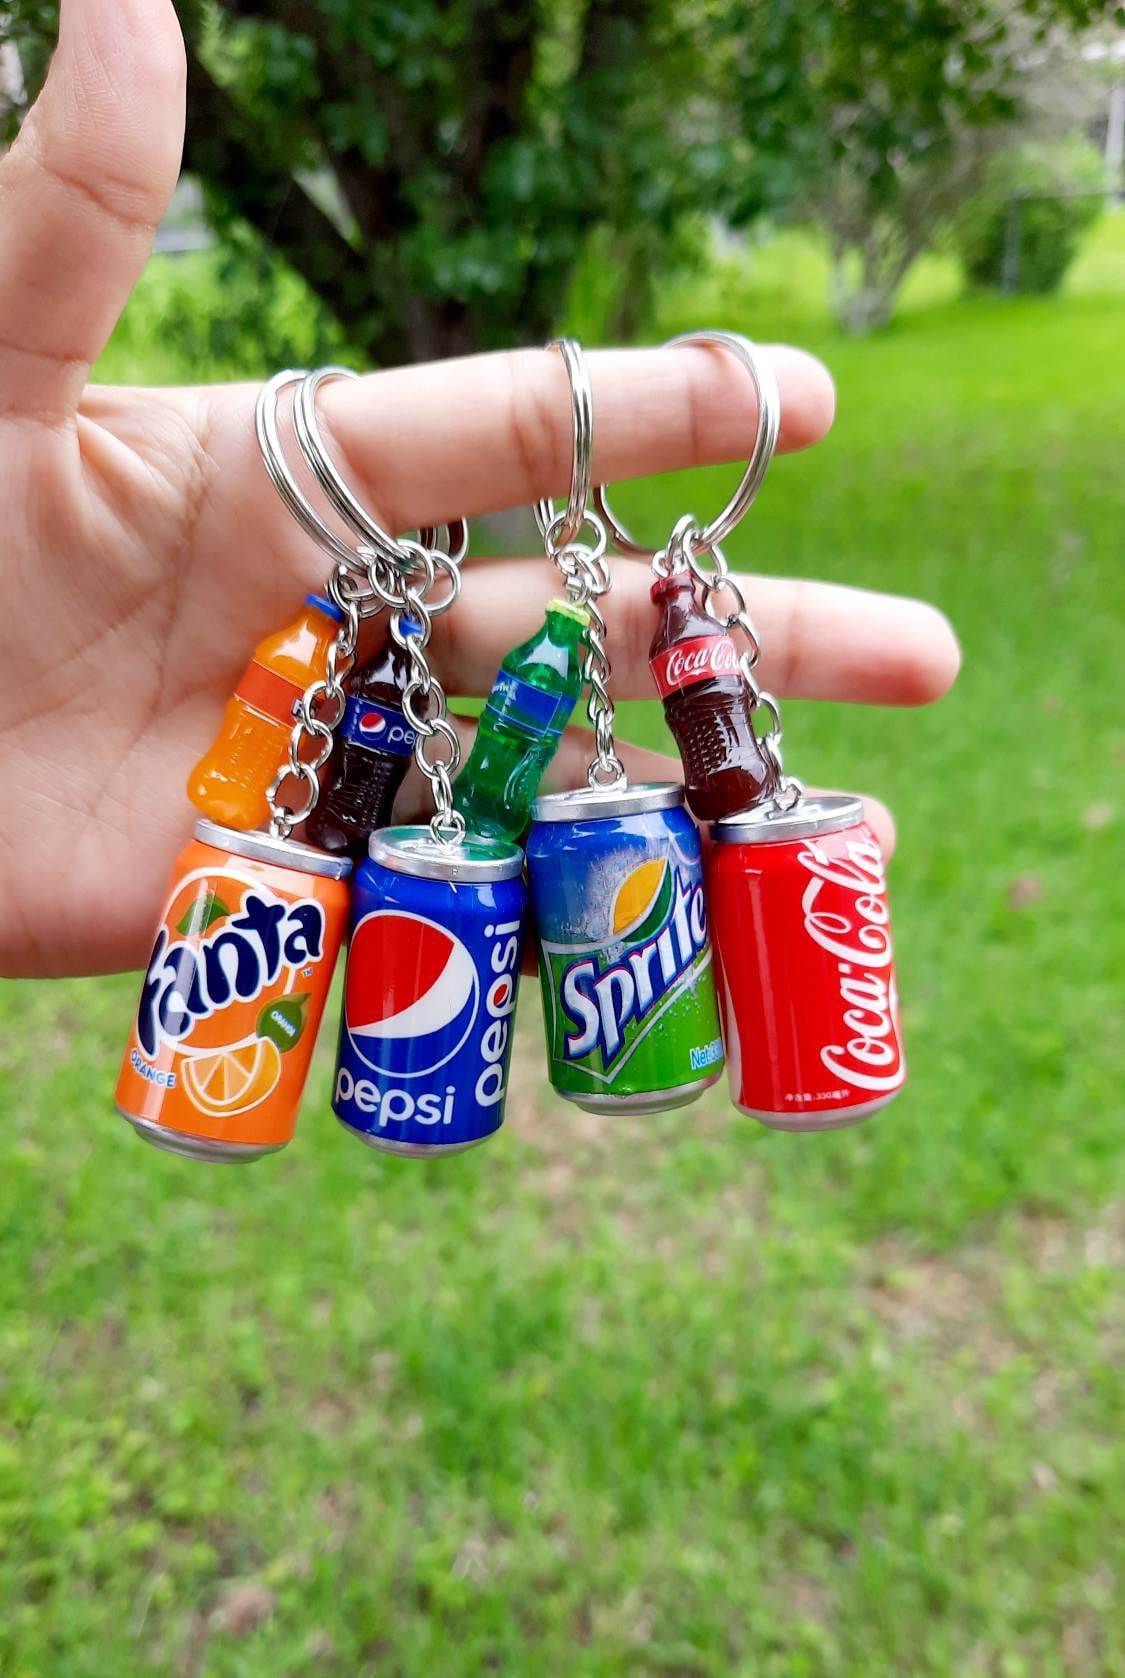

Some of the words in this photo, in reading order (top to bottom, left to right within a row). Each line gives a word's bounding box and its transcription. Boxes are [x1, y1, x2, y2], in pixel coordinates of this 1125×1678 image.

[475, 920, 521, 1108] pepsi
[561, 866, 708, 1068] Sprite
[130, 1048, 177, 1088] ORANGE
[335, 1067, 456, 1127] pepsi
